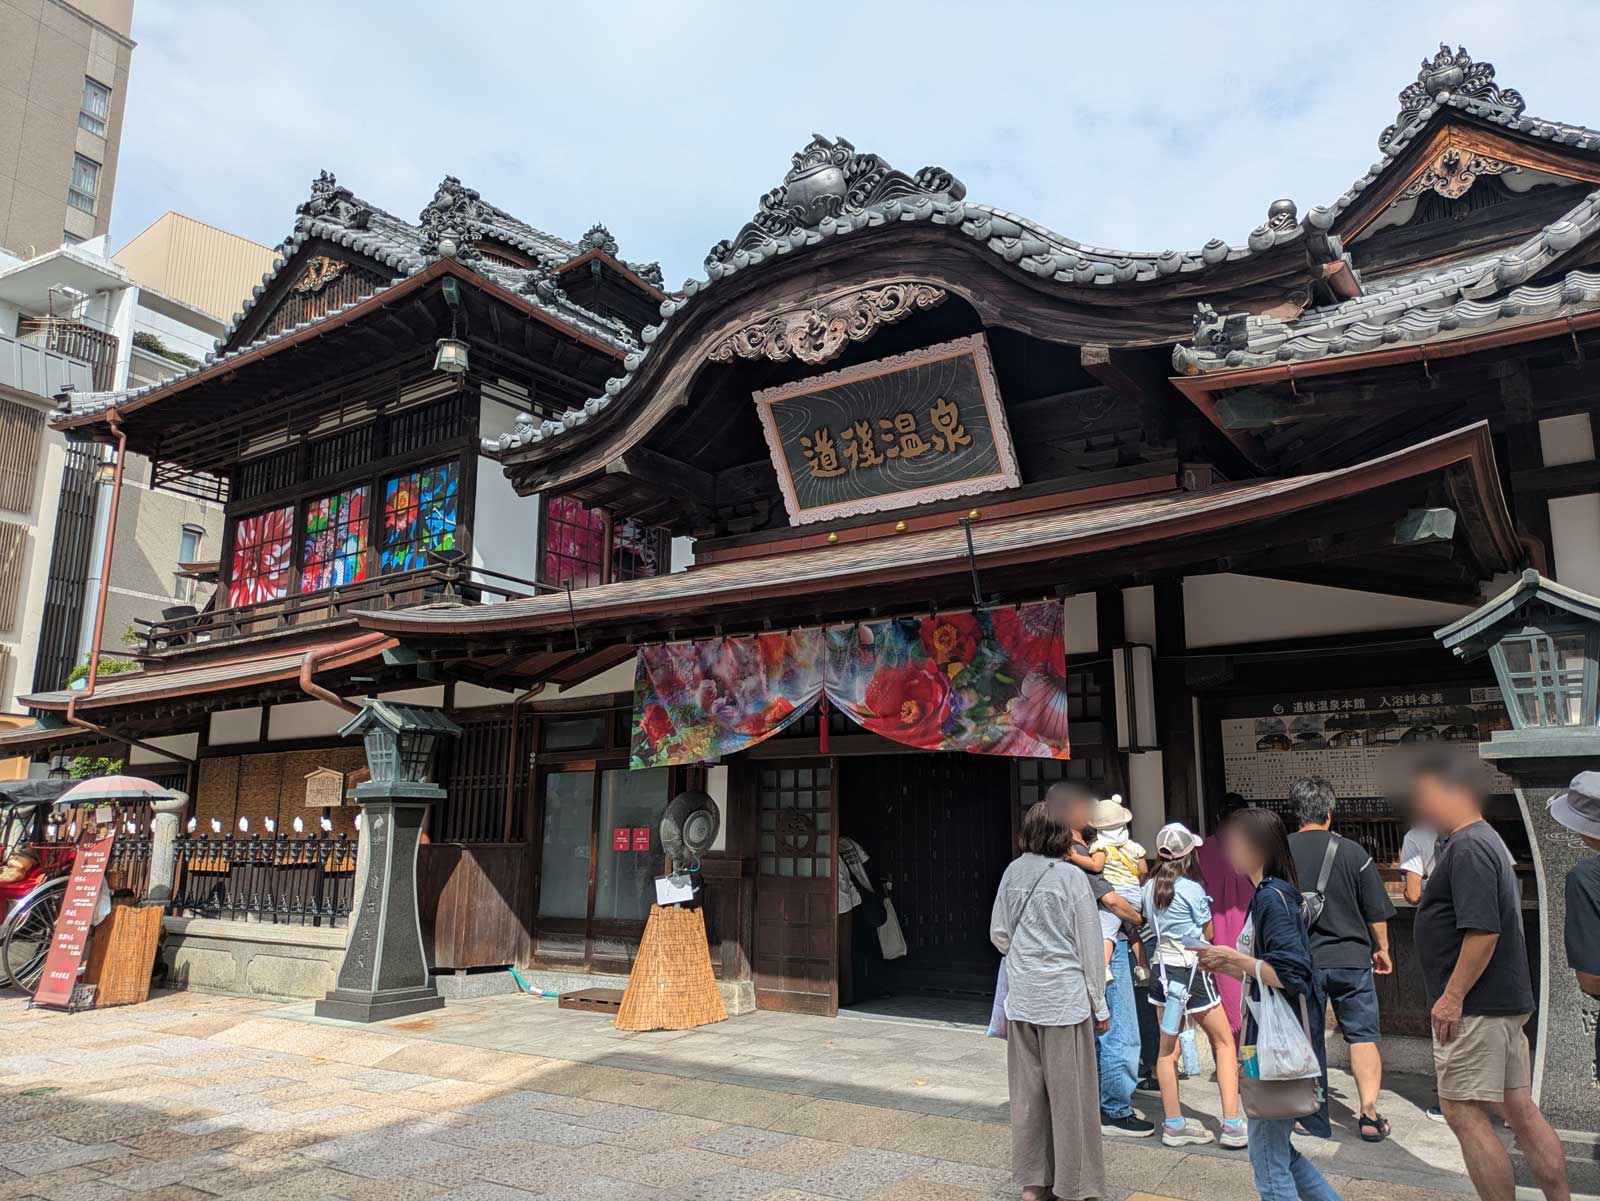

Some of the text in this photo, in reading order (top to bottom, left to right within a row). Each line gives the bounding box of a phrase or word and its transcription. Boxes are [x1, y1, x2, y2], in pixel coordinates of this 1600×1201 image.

[800, 398, 973, 479] 道後温泉
[1293, 692, 1444, 714] 道後温泉本館 入浴料金表
